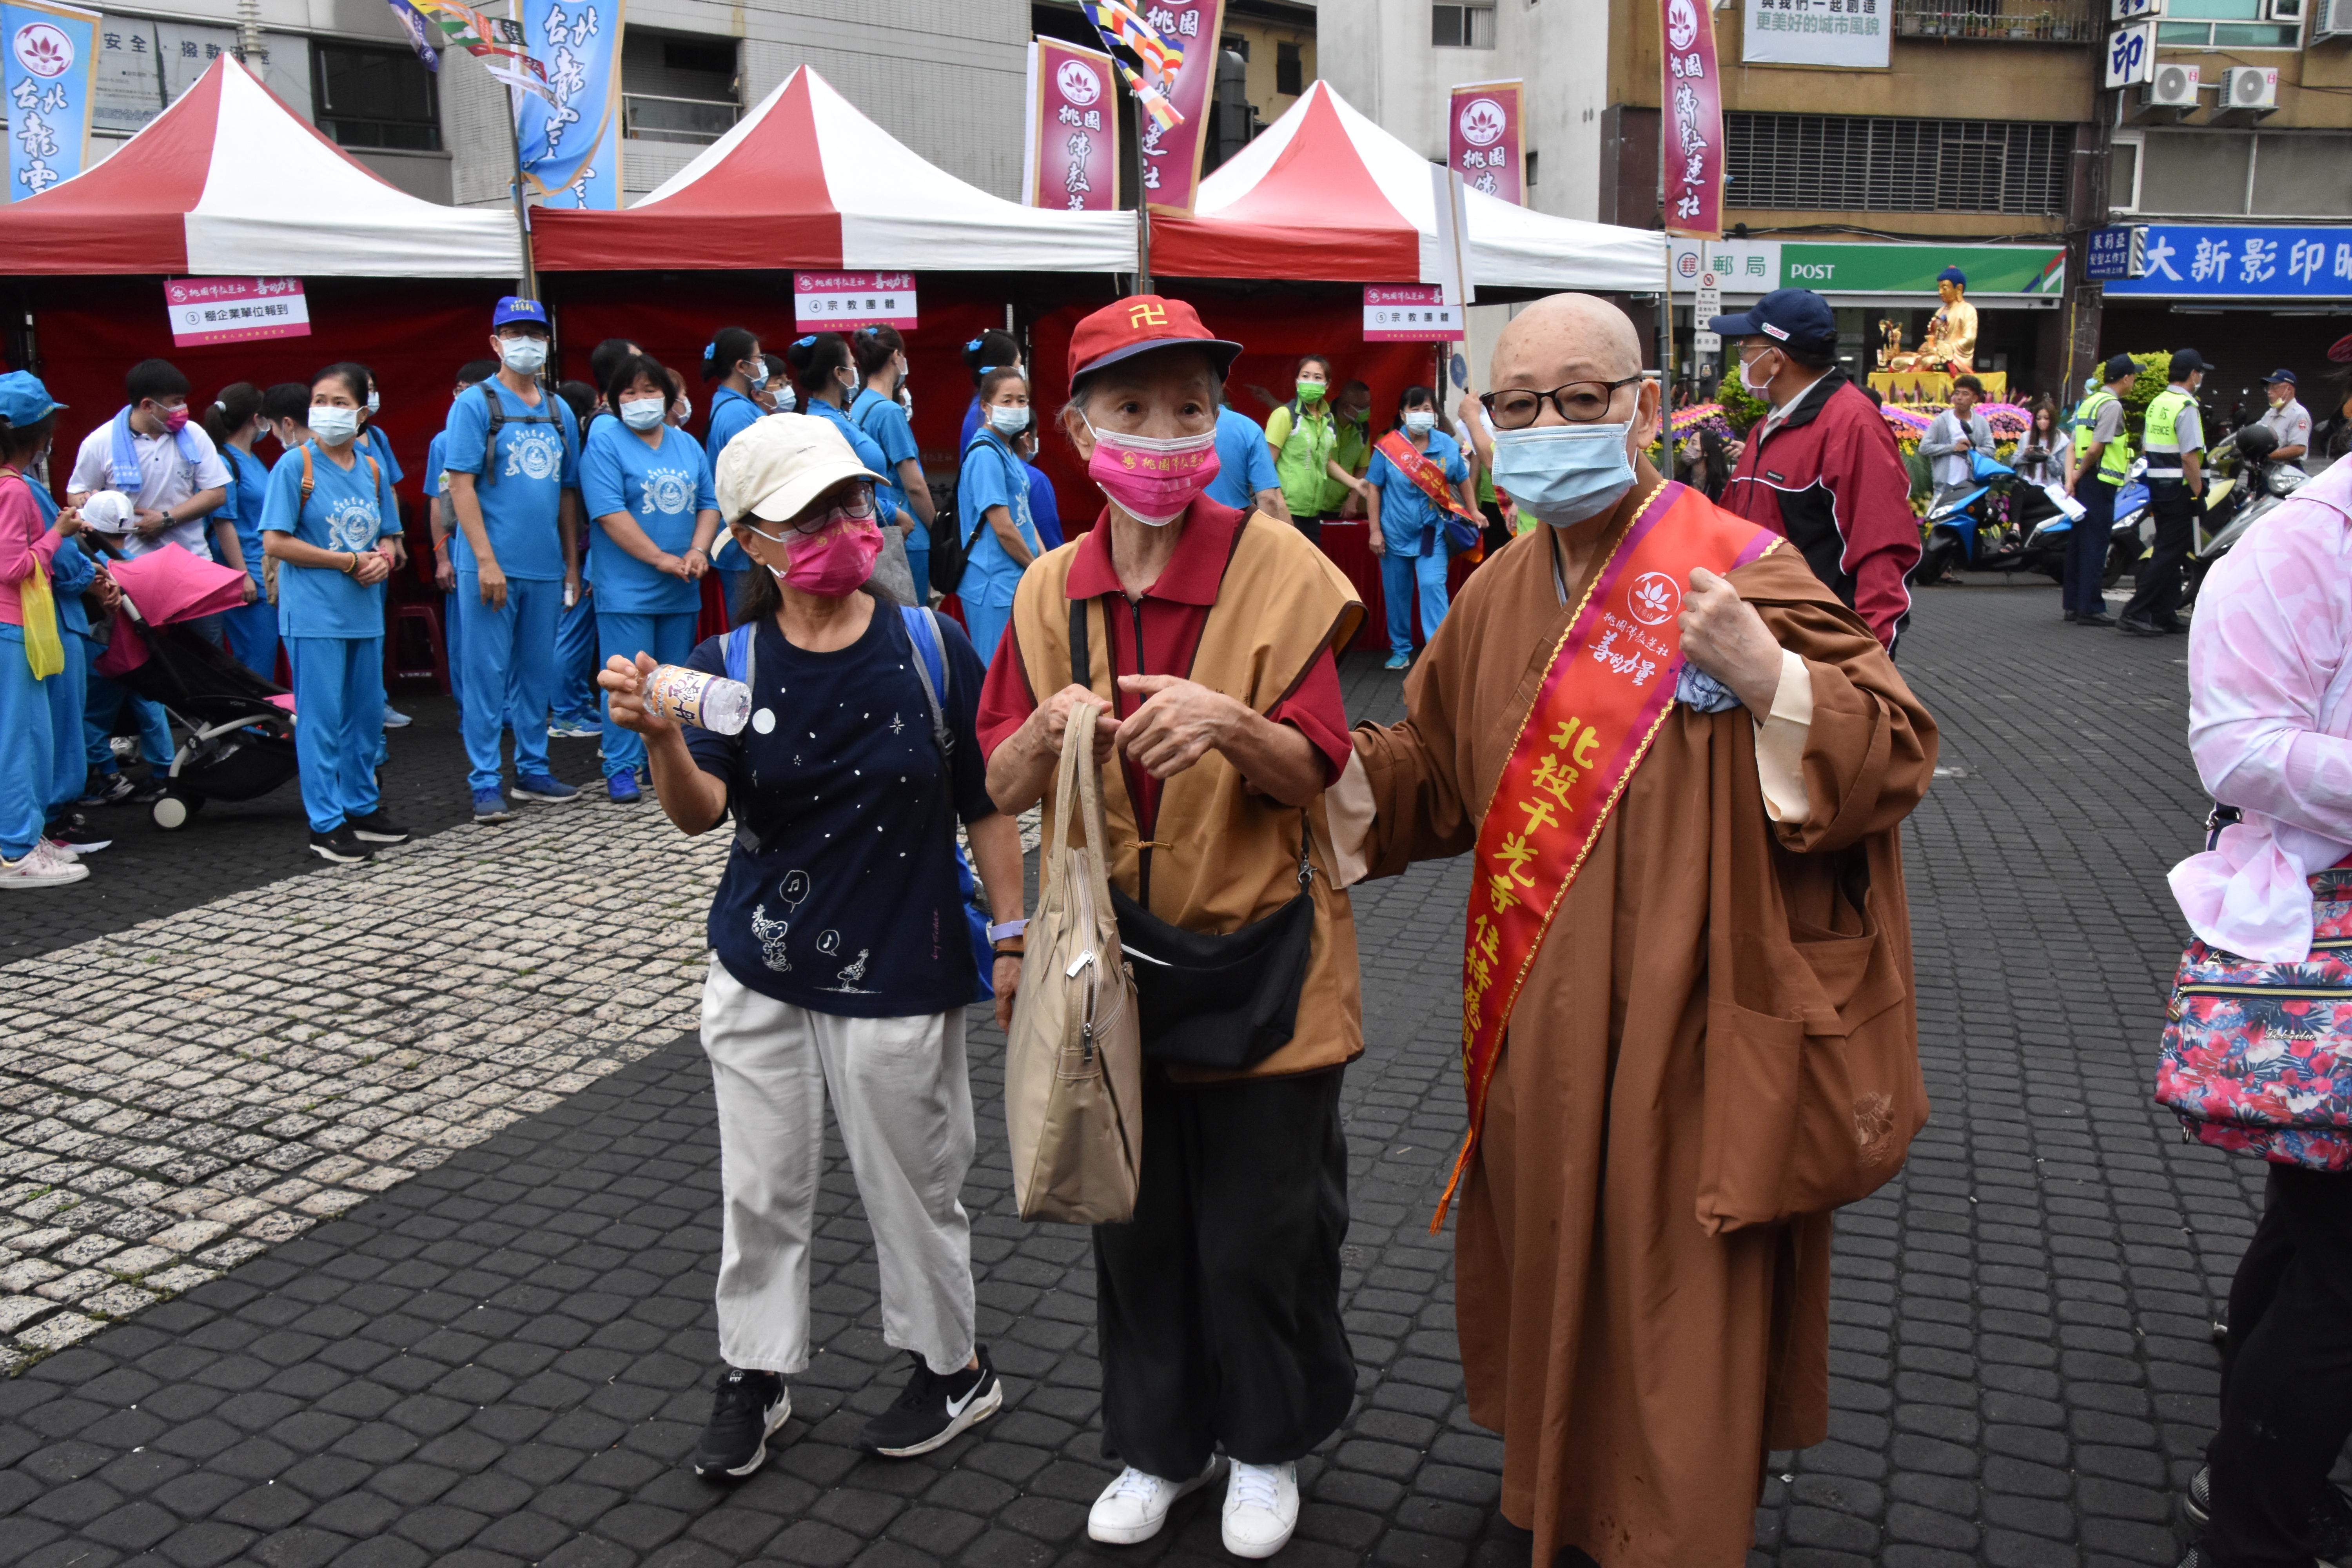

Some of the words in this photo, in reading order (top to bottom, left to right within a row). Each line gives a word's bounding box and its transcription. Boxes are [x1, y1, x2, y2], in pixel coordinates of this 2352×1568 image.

[1146, 5, 1200, 38] 桃園
[1757, 11, 1880, 35] 更美好的城市風貌
[2112, 31, 2143, 83] 印
[1058, 104, 1101, 132] 桃園
[1462, 146, 1506, 169] 桃園
[1713, 256, 1766, 276] 郵局
[1791, 264, 1835, 279] POST
[1602, 611, 1670, 658] 桃園佛教蓮社
[1588, 630, 1656, 686] 善的力量
